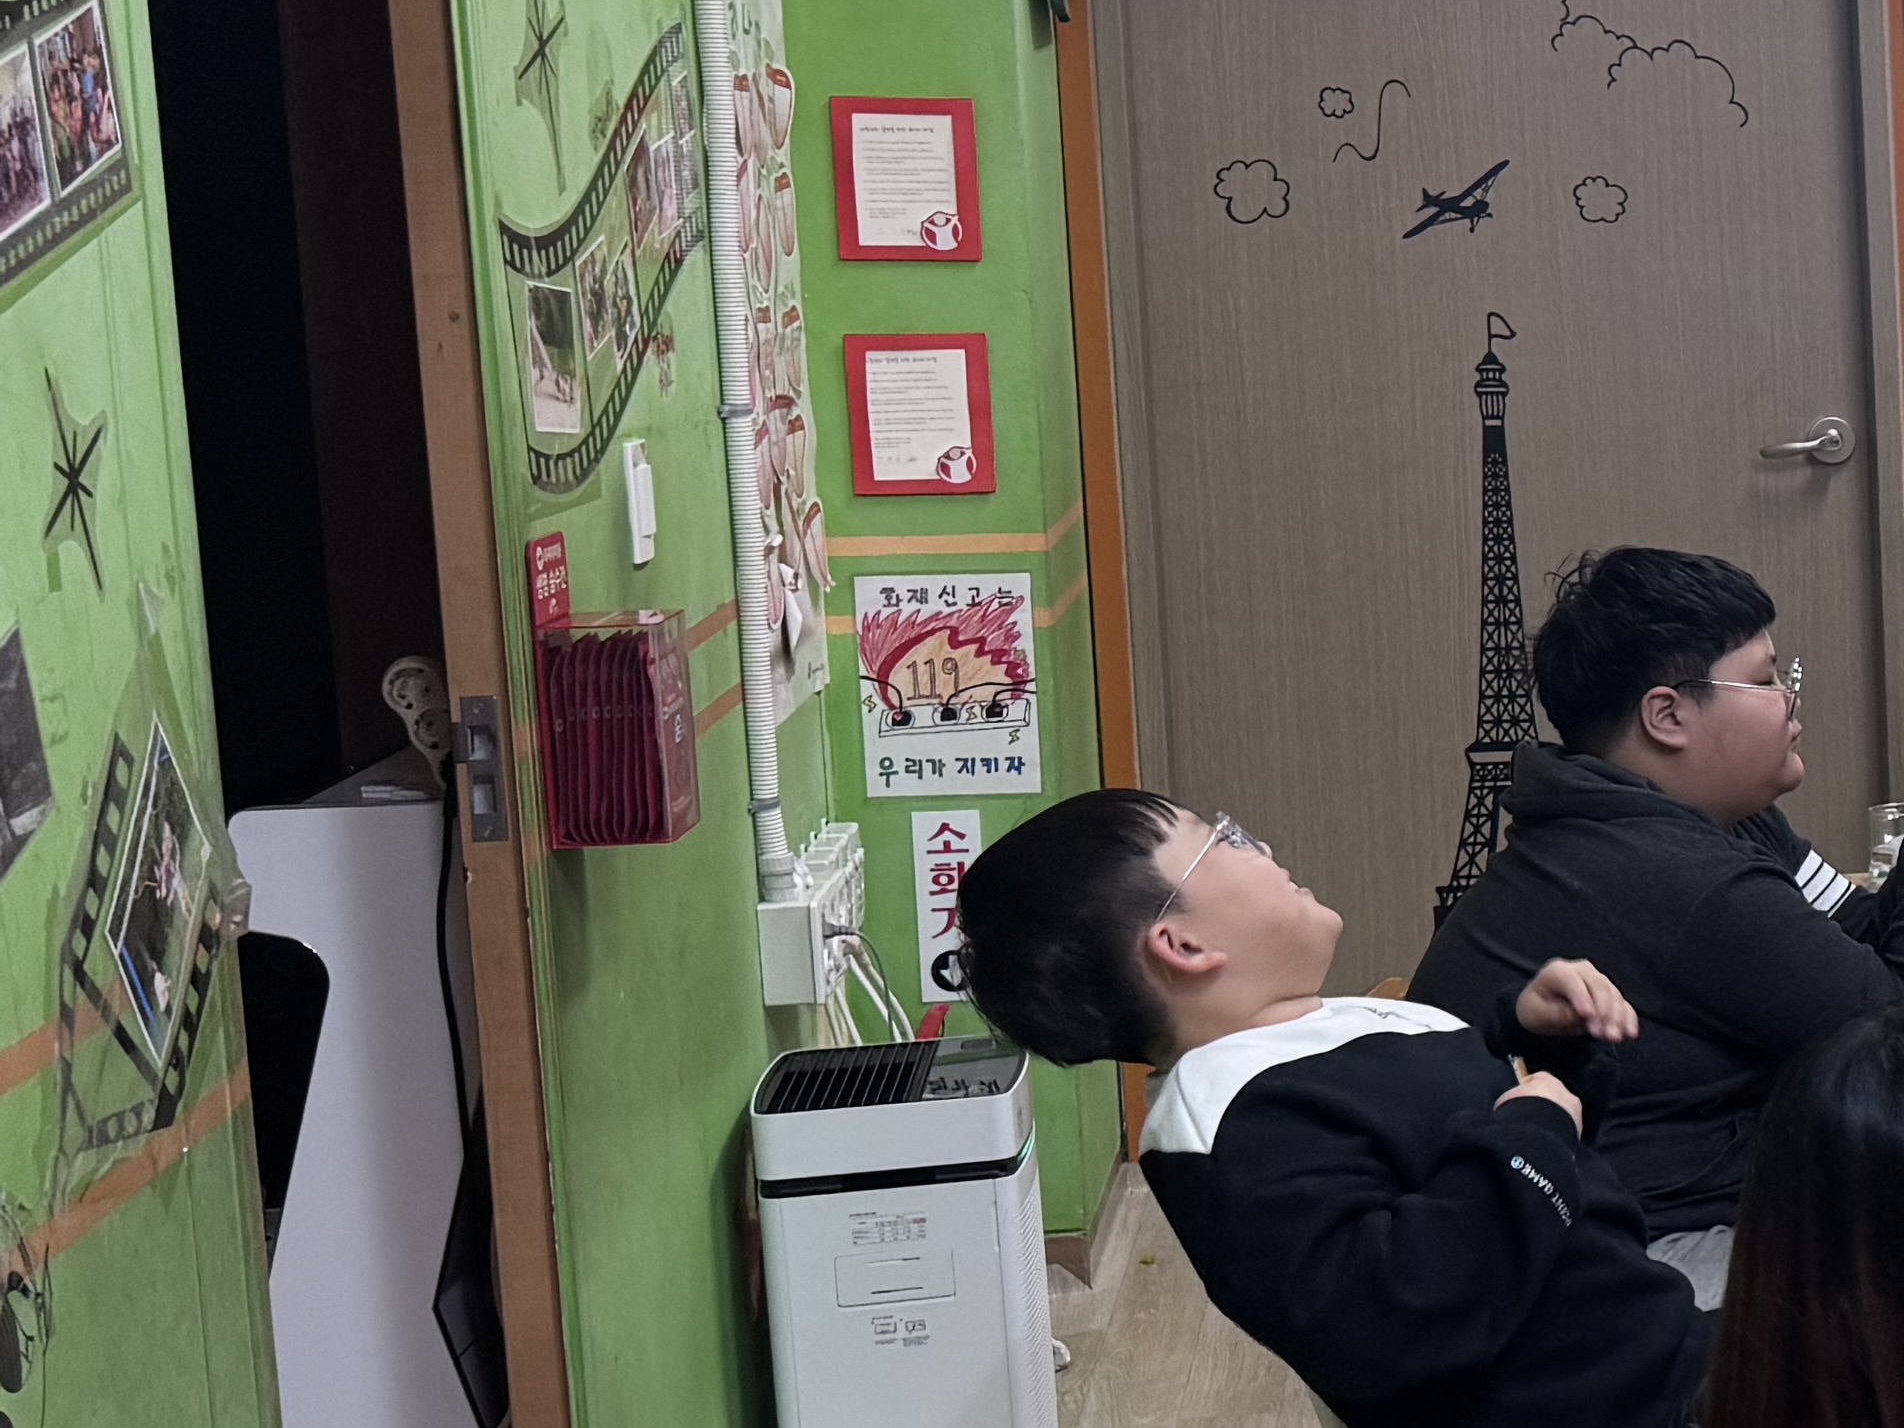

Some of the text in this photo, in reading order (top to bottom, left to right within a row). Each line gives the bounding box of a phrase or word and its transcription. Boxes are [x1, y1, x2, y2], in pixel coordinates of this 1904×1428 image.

[906, 657, 960, 701] 119
[878, 755, 1026, 789] 우리가 지키자
